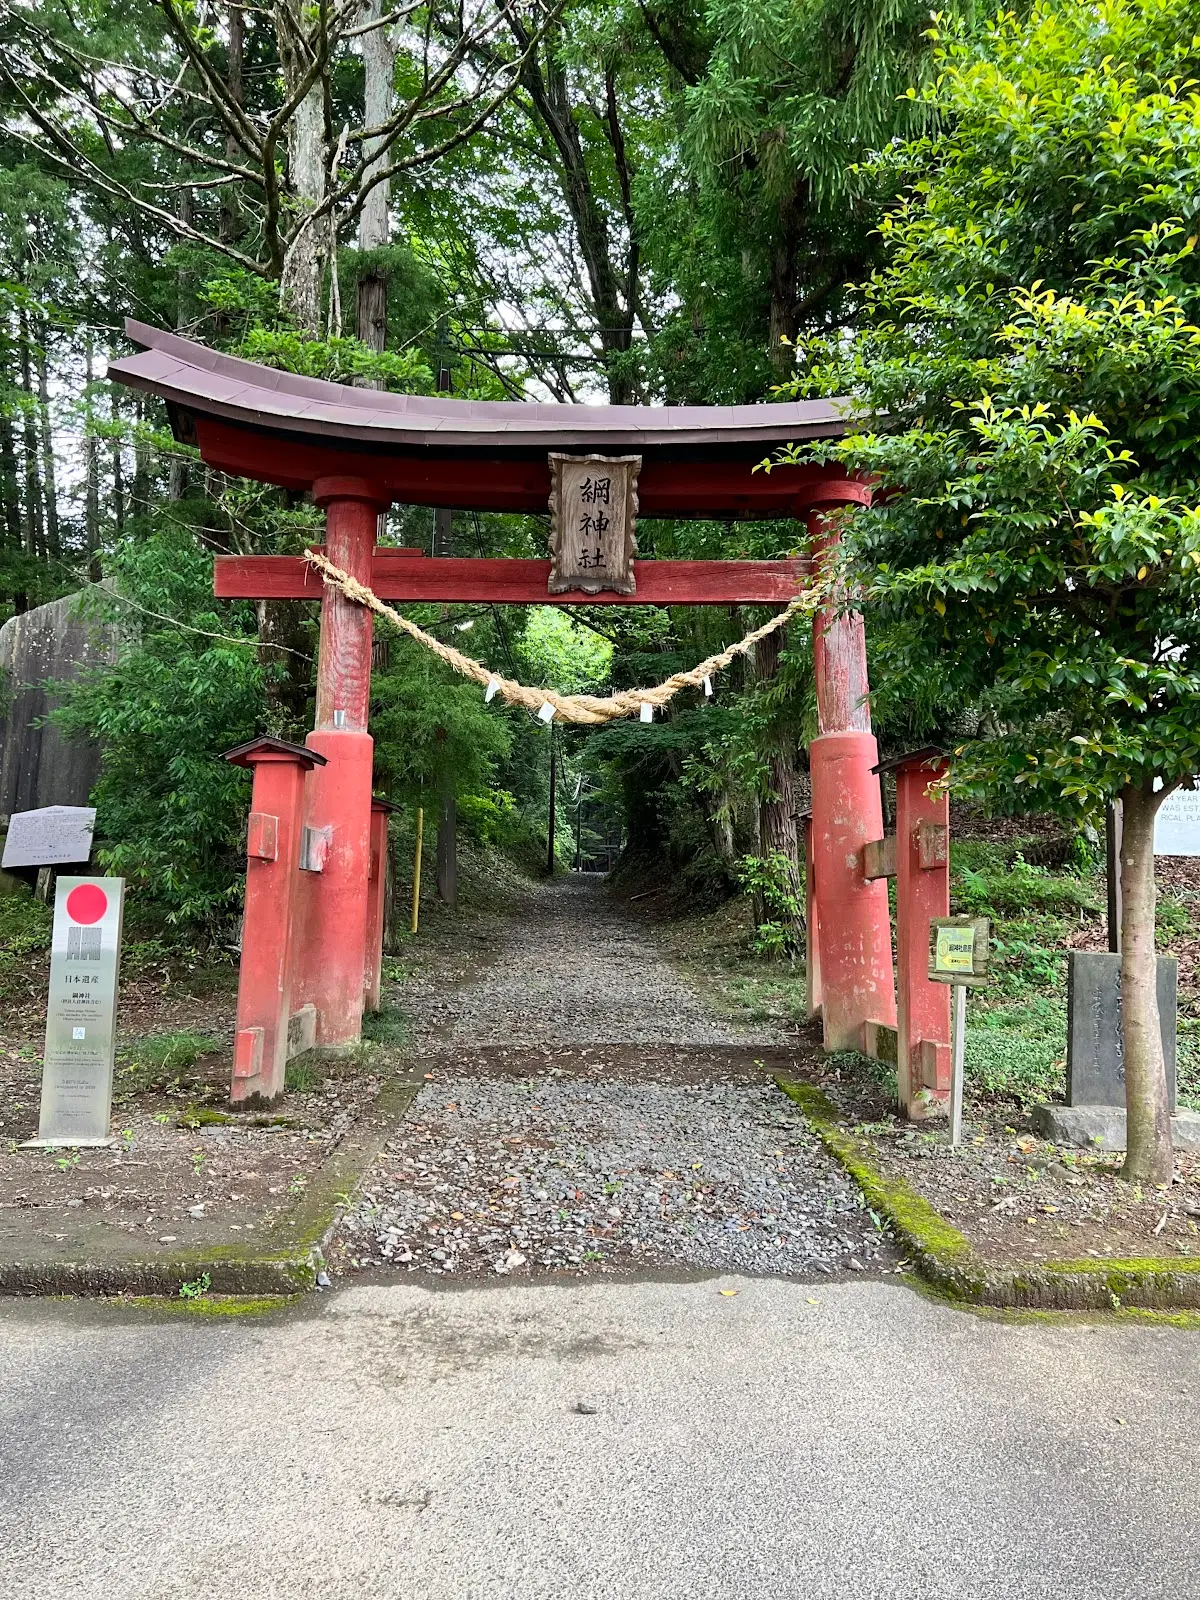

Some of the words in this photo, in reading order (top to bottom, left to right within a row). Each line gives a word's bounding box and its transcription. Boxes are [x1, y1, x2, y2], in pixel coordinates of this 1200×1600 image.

[577, 477, 611, 569] 綱神社
[1162, 804, 1181, 812] WAS
[65, 975, 99, 984] 日本遺産
